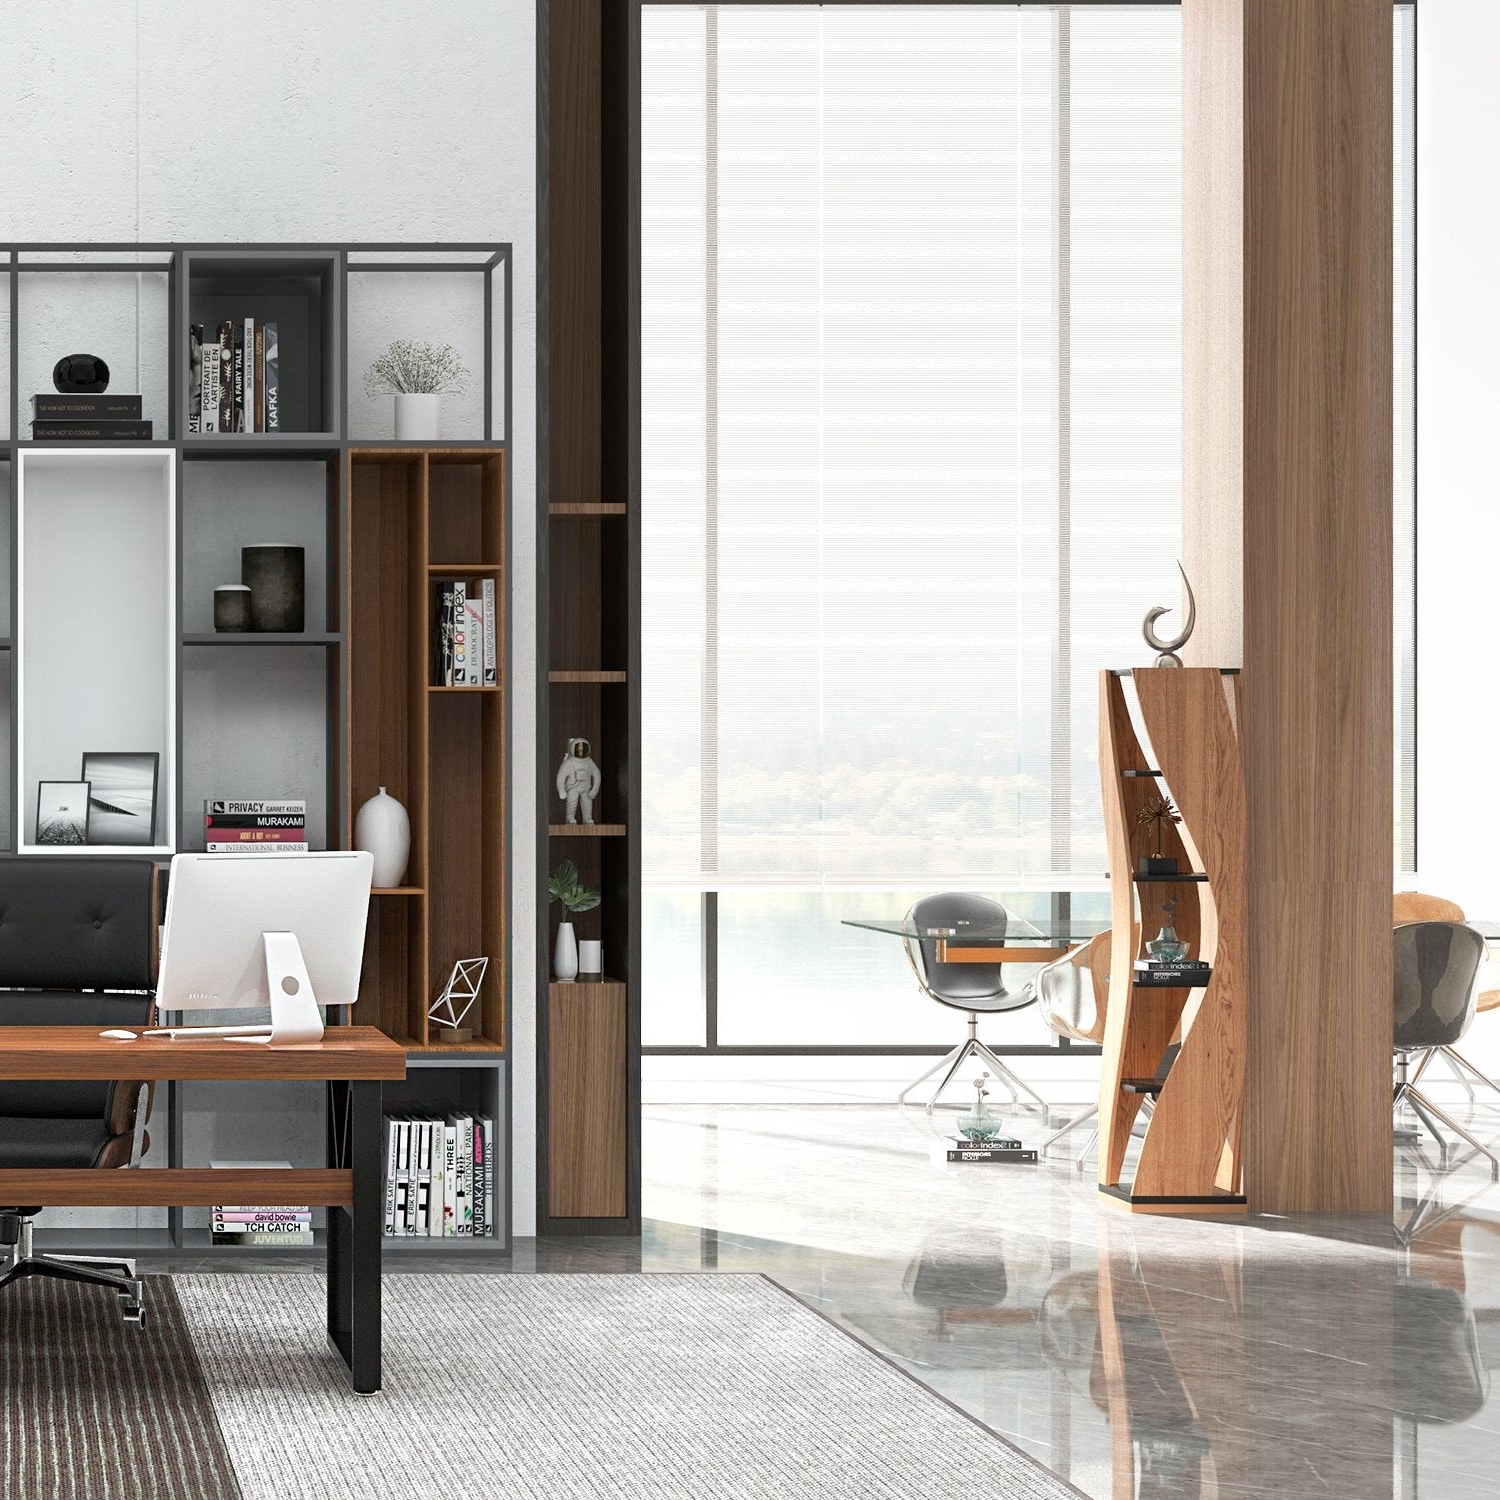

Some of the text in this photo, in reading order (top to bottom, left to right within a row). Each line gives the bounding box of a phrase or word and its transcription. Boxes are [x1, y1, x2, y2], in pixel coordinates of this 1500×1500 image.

[204, 350, 210, 362] DE
[212, 349, 218, 361] EN
[269, 387, 277, 427] KAFKA
[485, 582, 493, 612] POLITICS
[454, 589, 465, 663] color index
[229, 803, 264, 812] PRIVACY
[257, 818, 304, 826] MURAKAMI
[475, 1167, 483, 1234] MURAKAMI
[255, 1213, 296, 1221] david bowie
[245, 1223, 301, 1231] TCH CATCH
[253, 1235, 303, 1244] JUVENTUD
